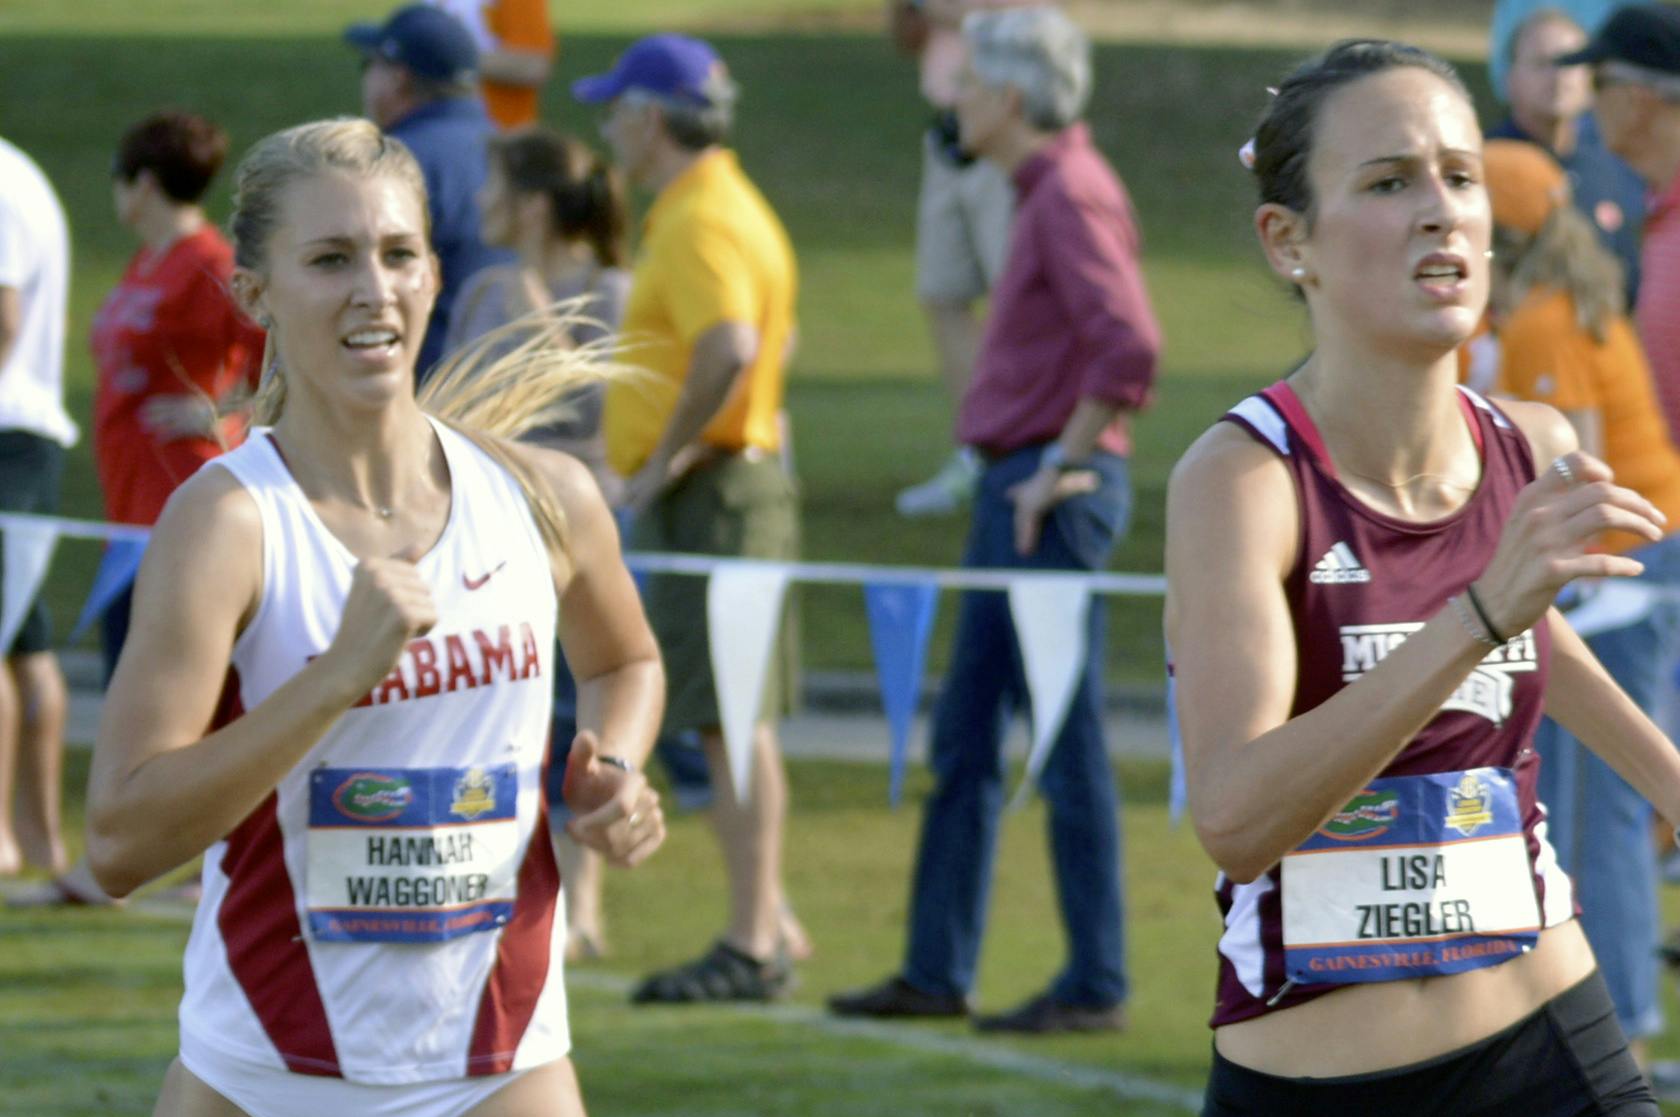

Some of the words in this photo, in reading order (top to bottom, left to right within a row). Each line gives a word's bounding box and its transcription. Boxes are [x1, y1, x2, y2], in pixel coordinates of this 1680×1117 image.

[307, 617, 541, 708] ABAMA
[367, 833, 473, 866] HANNAH
[346, 873, 488, 906] WAGGONER
[1380, 854, 1447, 891] LISA
[1356, 899, 1474, 939] ZIEGLER
